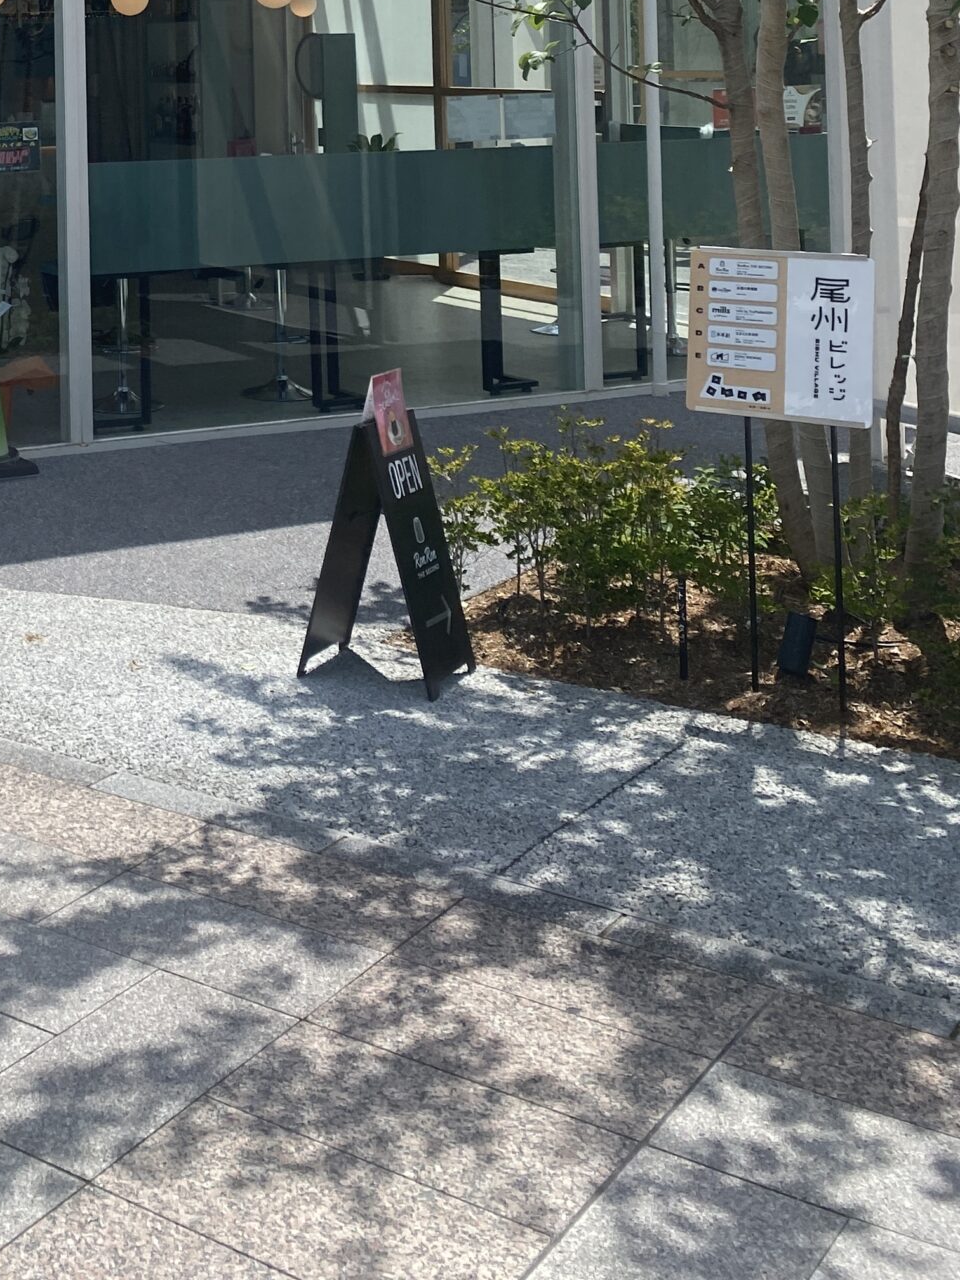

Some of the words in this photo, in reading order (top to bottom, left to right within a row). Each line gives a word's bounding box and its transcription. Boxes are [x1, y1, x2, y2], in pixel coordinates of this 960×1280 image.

[712, 306, 730, 314] mills
[810, 277, 851, 401] 尾州ビレッジ
[388, 454, 423, 499] OPEN
